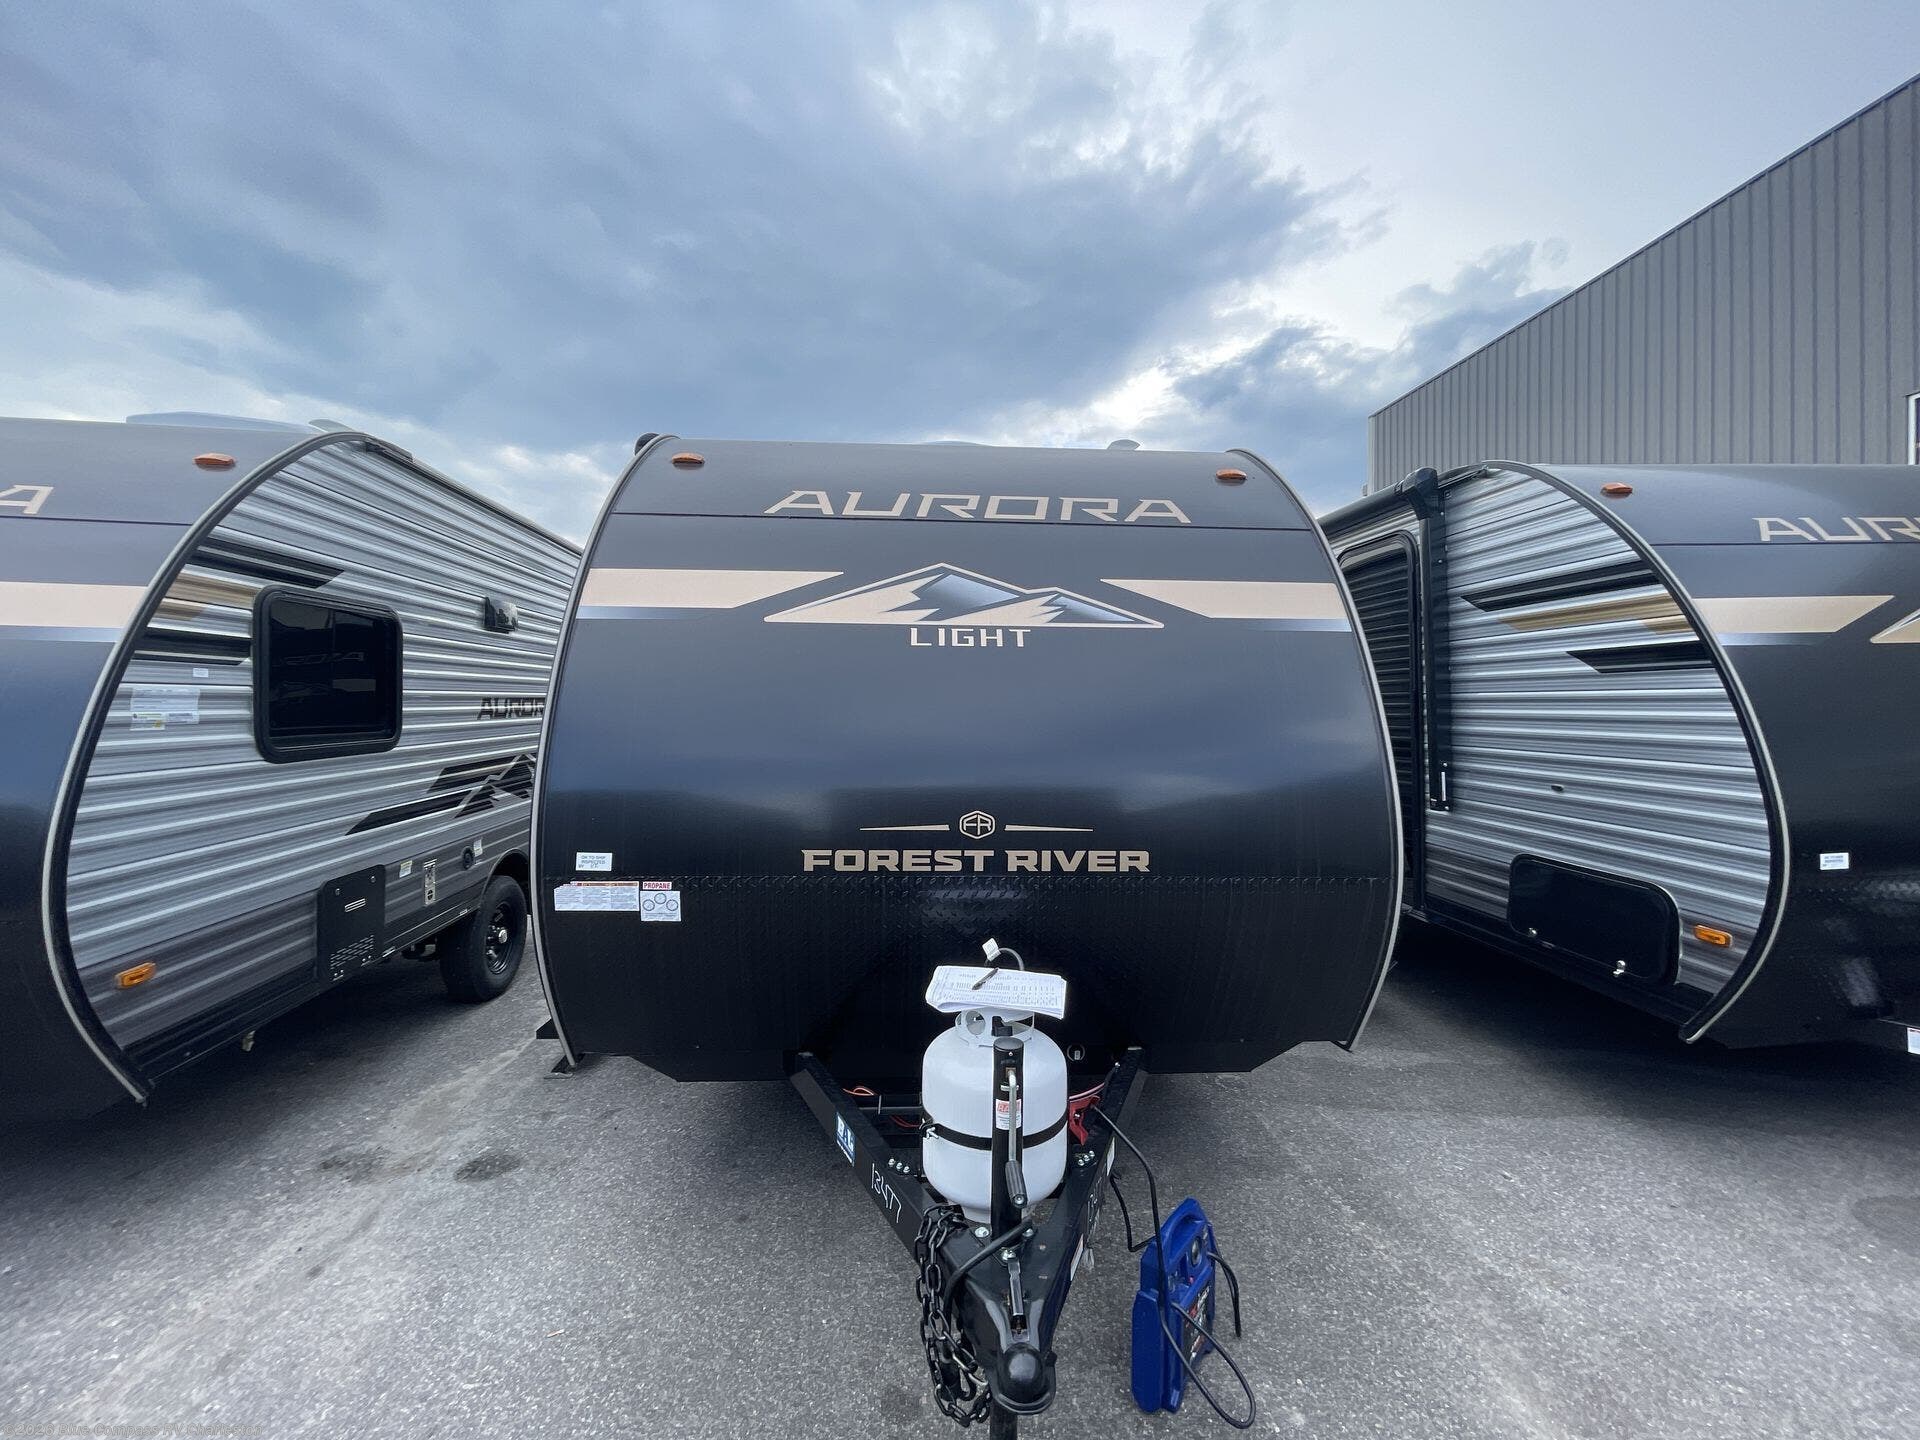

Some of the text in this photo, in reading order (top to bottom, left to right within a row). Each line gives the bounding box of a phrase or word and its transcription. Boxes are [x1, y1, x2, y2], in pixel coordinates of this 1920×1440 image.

[763, 490, 1192, 524] AURORA
[1751, 516, 1920, 542] AUR
[909, 627, 1031, 647] LIGHT
[801, 849, 1150, 872] FOREST RIVER
